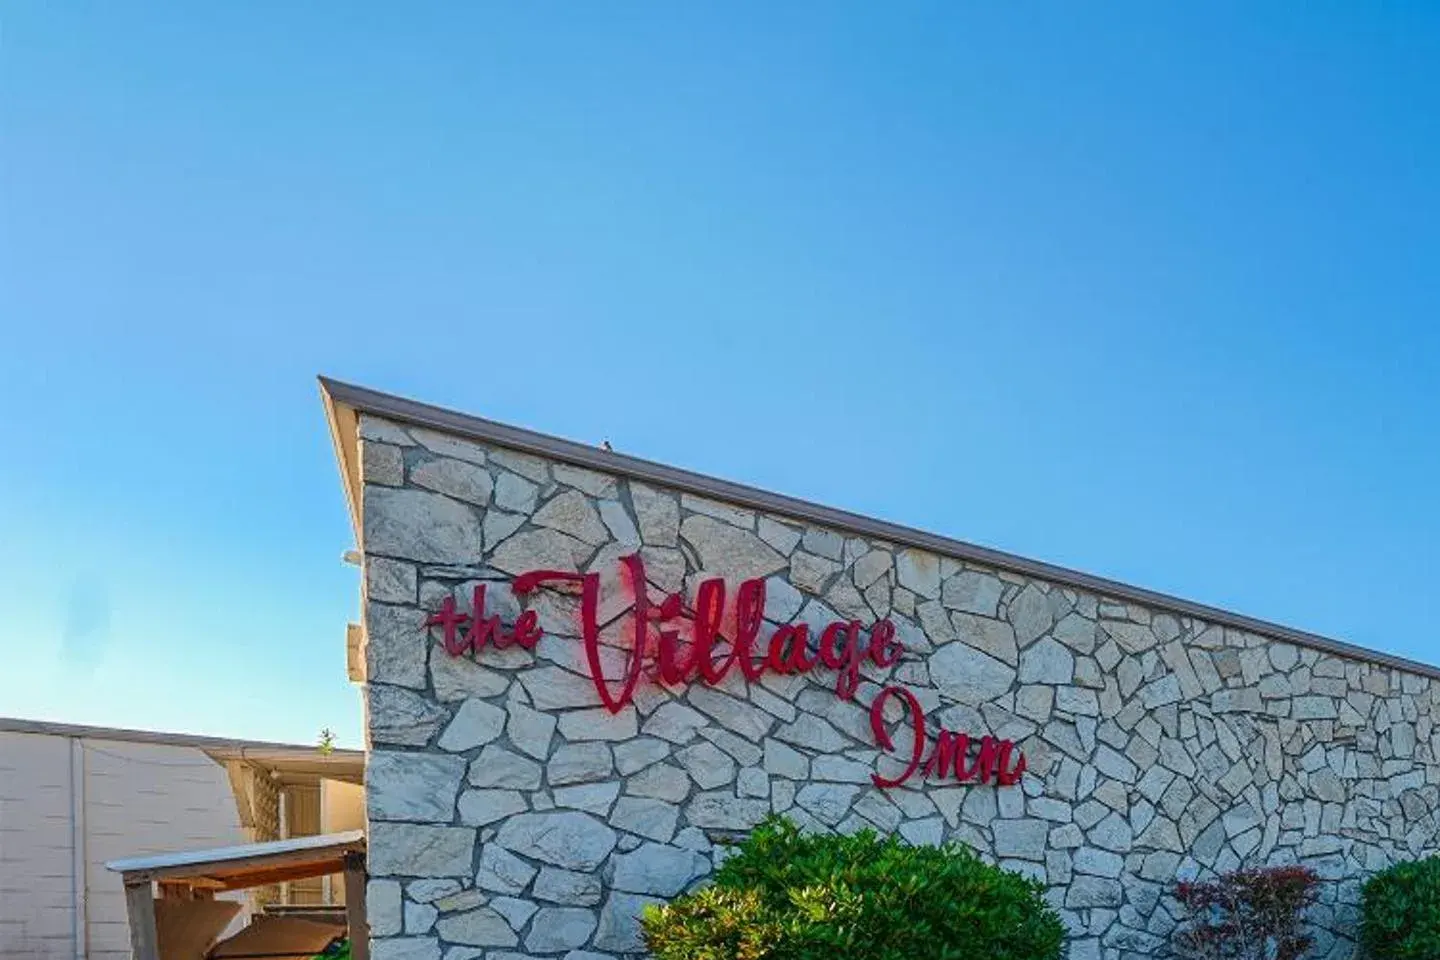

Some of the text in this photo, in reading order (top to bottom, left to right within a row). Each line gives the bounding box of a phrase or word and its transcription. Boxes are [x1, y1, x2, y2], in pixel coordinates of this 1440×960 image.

[423, 551, 903, 716] the Village
[869, 684, 1028, 788] Inn
